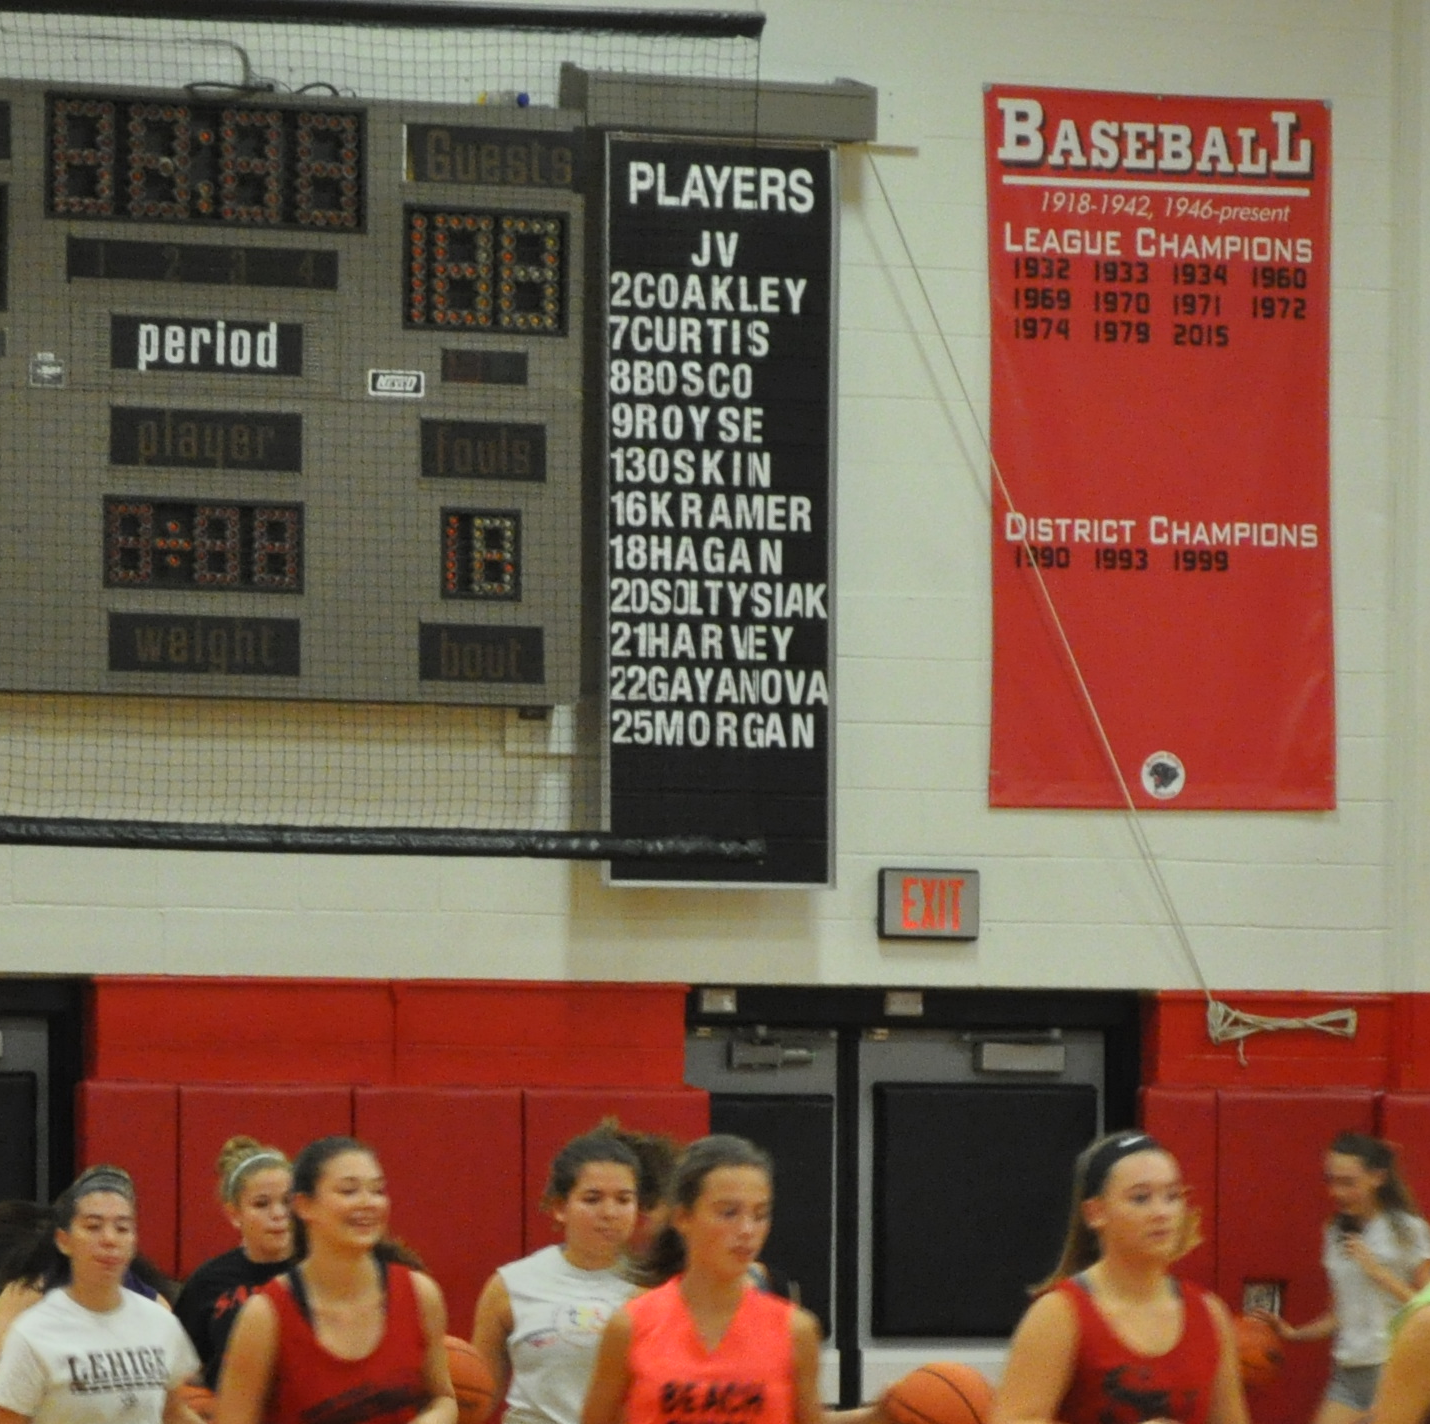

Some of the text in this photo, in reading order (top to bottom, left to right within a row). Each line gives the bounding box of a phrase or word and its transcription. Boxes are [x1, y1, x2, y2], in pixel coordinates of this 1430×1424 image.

[427, 128, 572, 185] Guests
[997, 97, 1314, 178] BASEBALL
[628, 160, 814, 214] PLAYERS
[1041, 191, 1290, 224] 1918-1942, 1946-present
[691, 230, 739, 268] JV
[1004, 221, 1313, 263] LEAGUE CHAMPIONS
[1014, 257, 1308, 290] 1932 1933 1934 1960
[1014, 287, 1307, 320] 1969 1970 1971 1972
[137, 320, 278, 372] period
[1014, 317, 1230, 347] 1974 1979 2015
[137, 409, 274, 466] player
[437, 425, 531, 475] fouls
[1005, 511, 1319, 548] DISTRICT CHAMPIONS
[1014, 545, 1230, 571] 1990 1993 1999
[135, 619, 273, 674] weight
[440, 630, 523, 679] bout
[901, 876, 965, 931] EXIT
